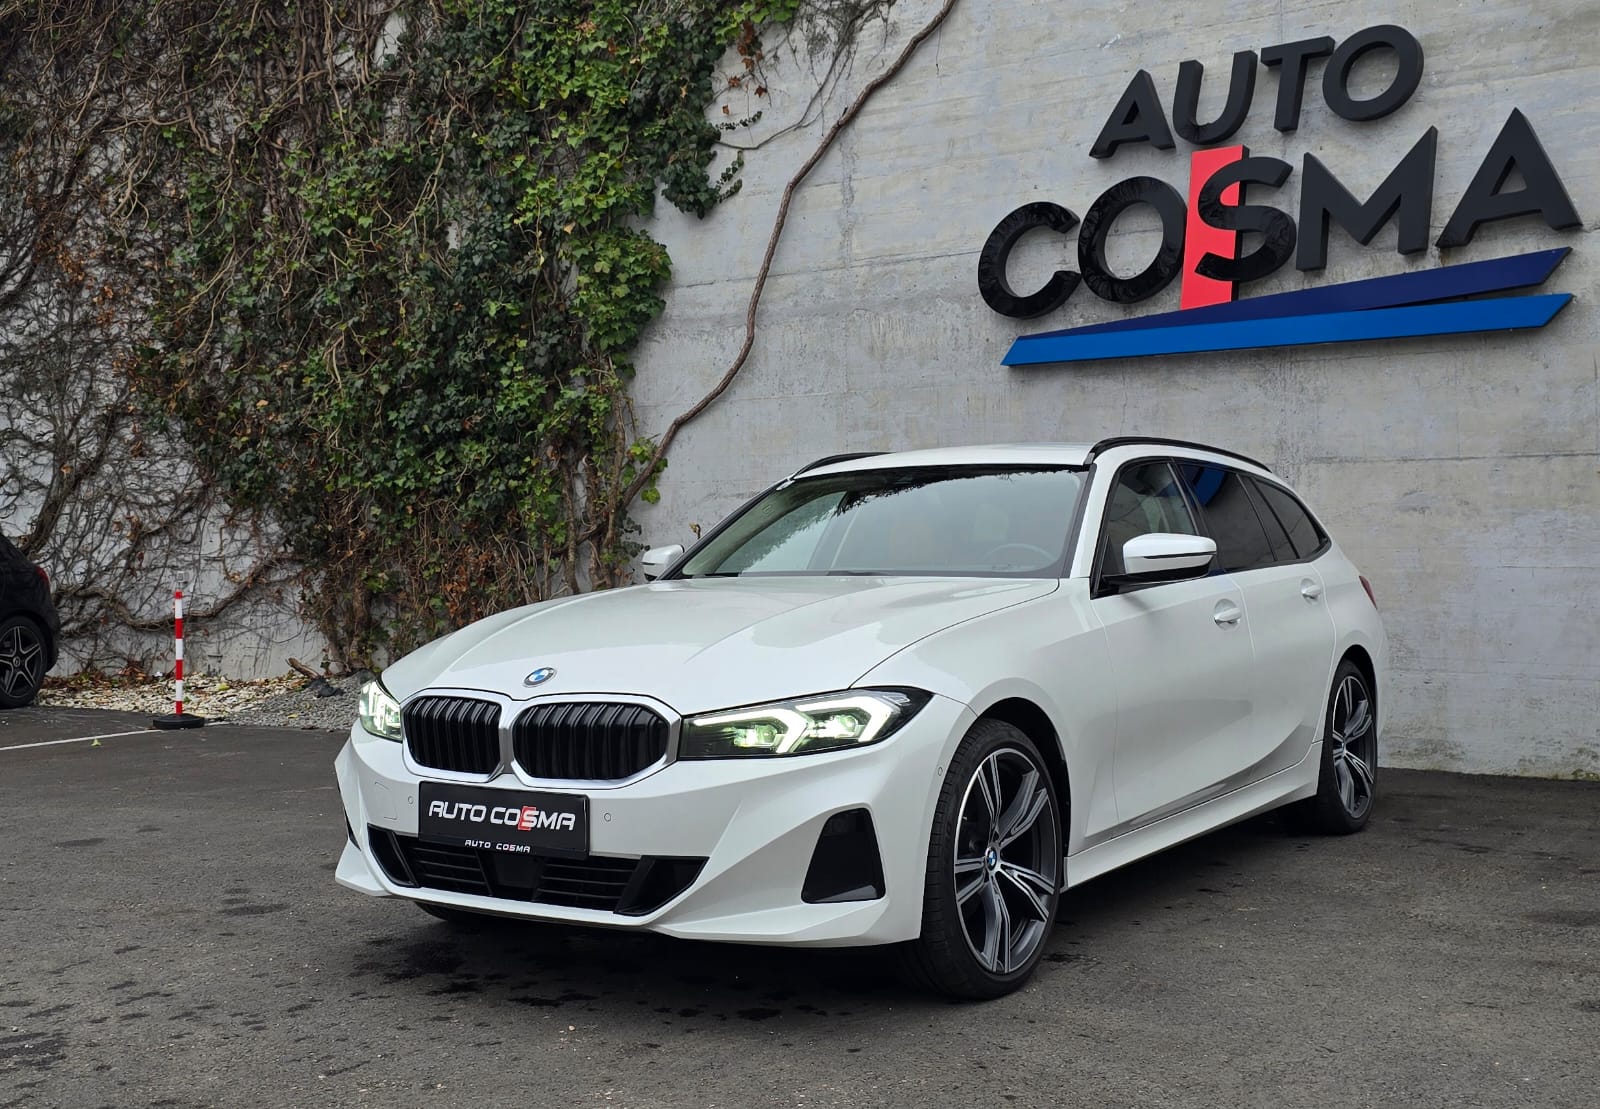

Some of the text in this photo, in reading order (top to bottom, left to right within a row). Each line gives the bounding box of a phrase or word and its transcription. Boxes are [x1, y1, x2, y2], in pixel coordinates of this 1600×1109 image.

[1089, 24, 1424, 160] AUTO
[977, 106, 1583, 319] COSMA
[428, 800, 576, 831] AUTO COSMA
[464, 839, 531, 853] AUTO COSMA
